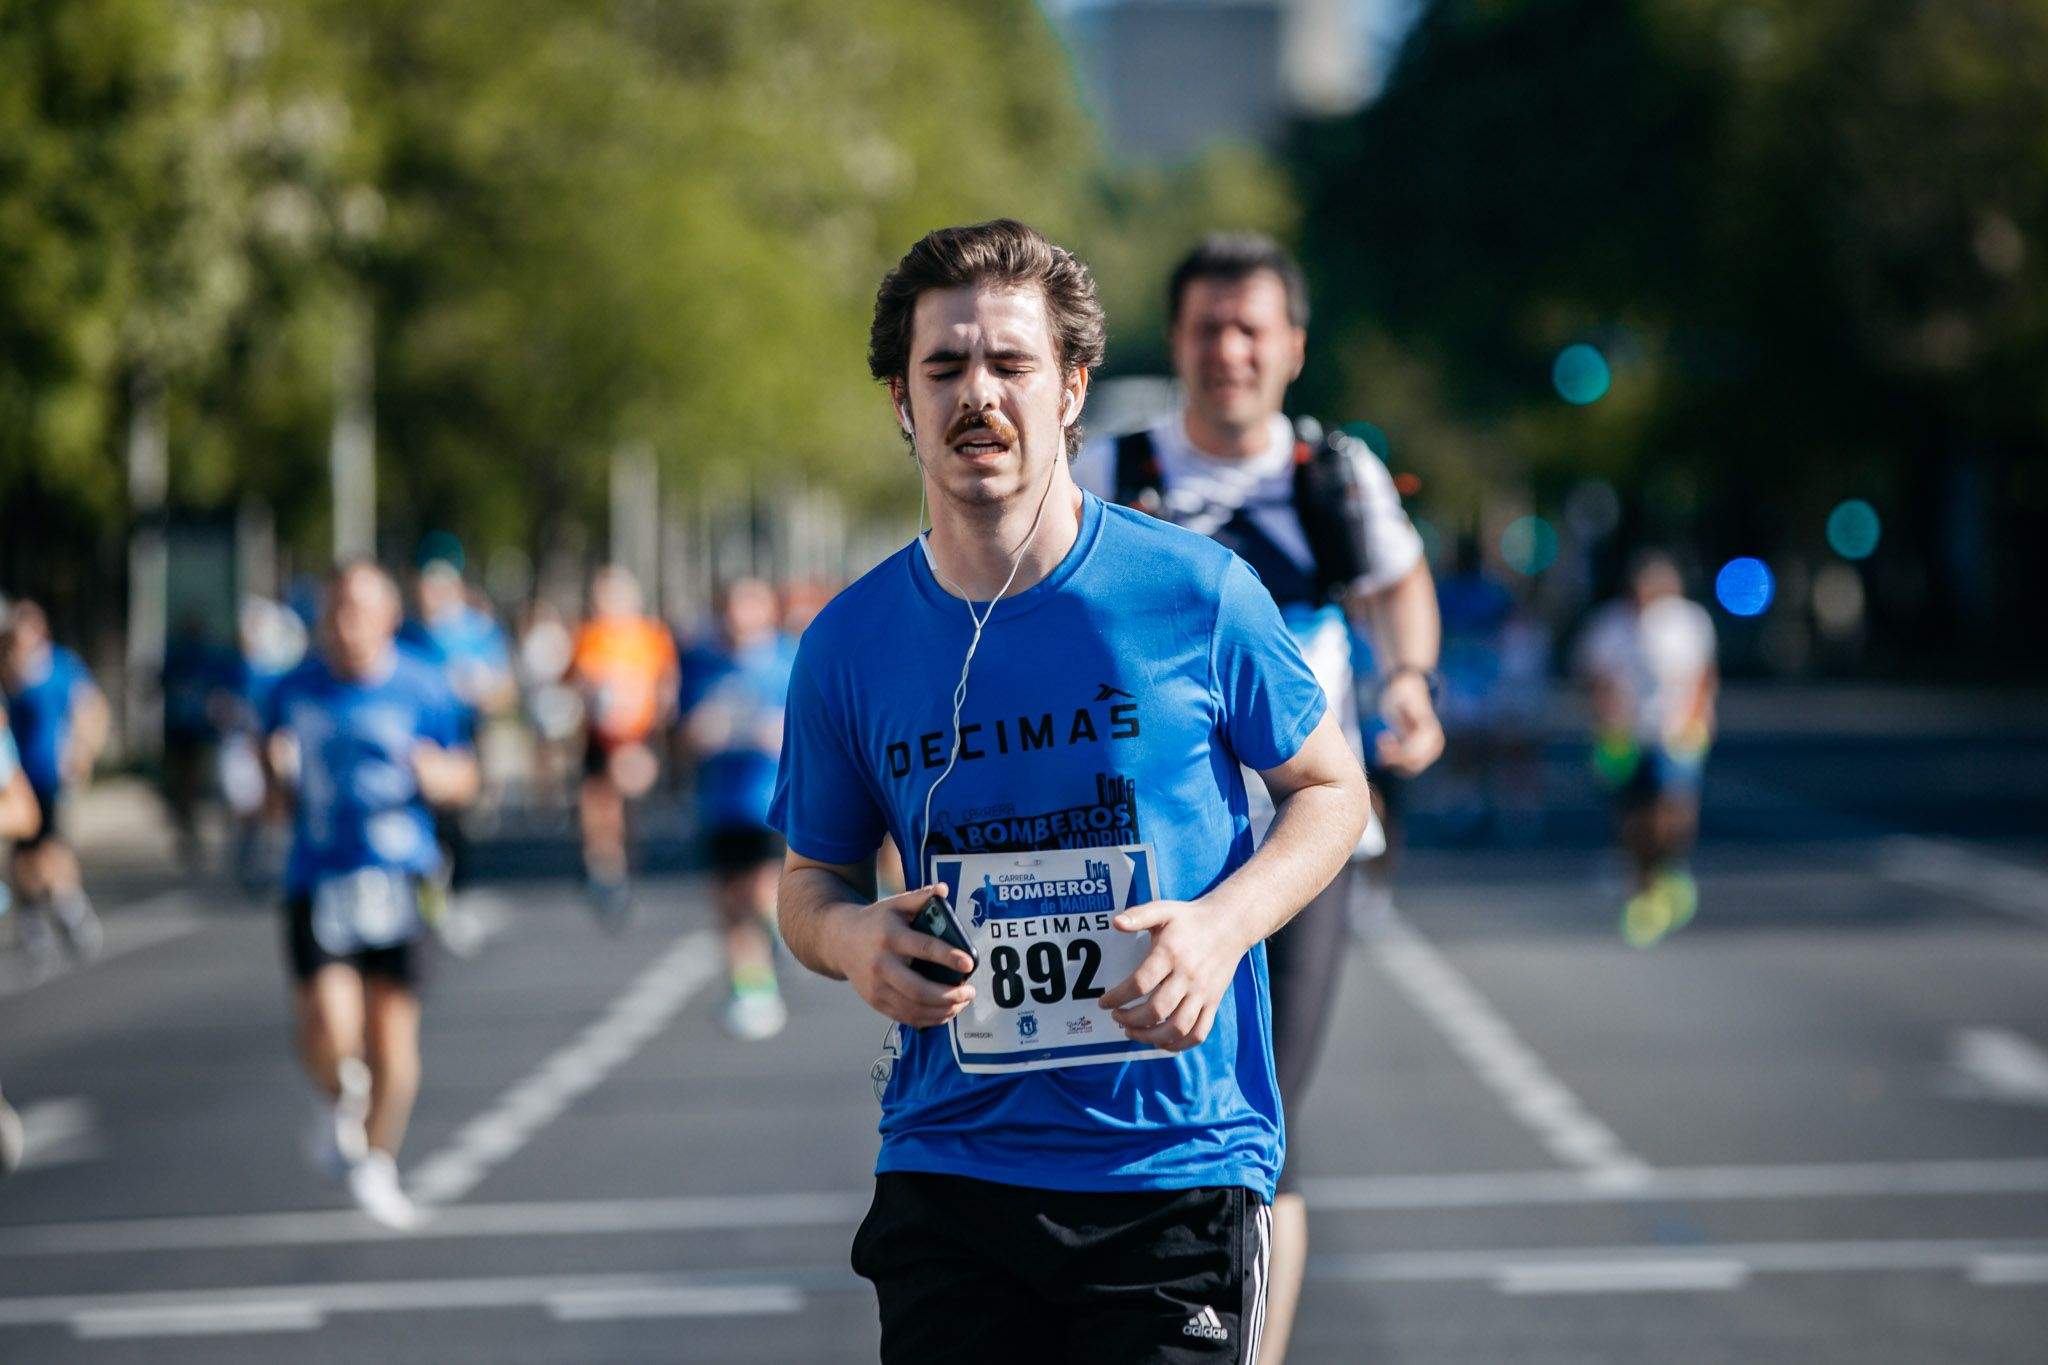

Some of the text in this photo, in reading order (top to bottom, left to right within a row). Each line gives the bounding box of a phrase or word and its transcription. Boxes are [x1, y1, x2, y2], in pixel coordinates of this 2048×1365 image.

[886, 703, 1139, 779] DECIMAS
[967, 803, 1130, 848] BOMBEROS
[998, 873, 1036, 883] CARRERA
[998, 878, 1108, 901] BOMBEROS
[1040, 894, 1110, 914] de MADRID
[990, 914, 1110, 939] DECIMAS
[990, 938, 1105, 1009] 892
[1183, 1325, 1228, 1340] adidas
